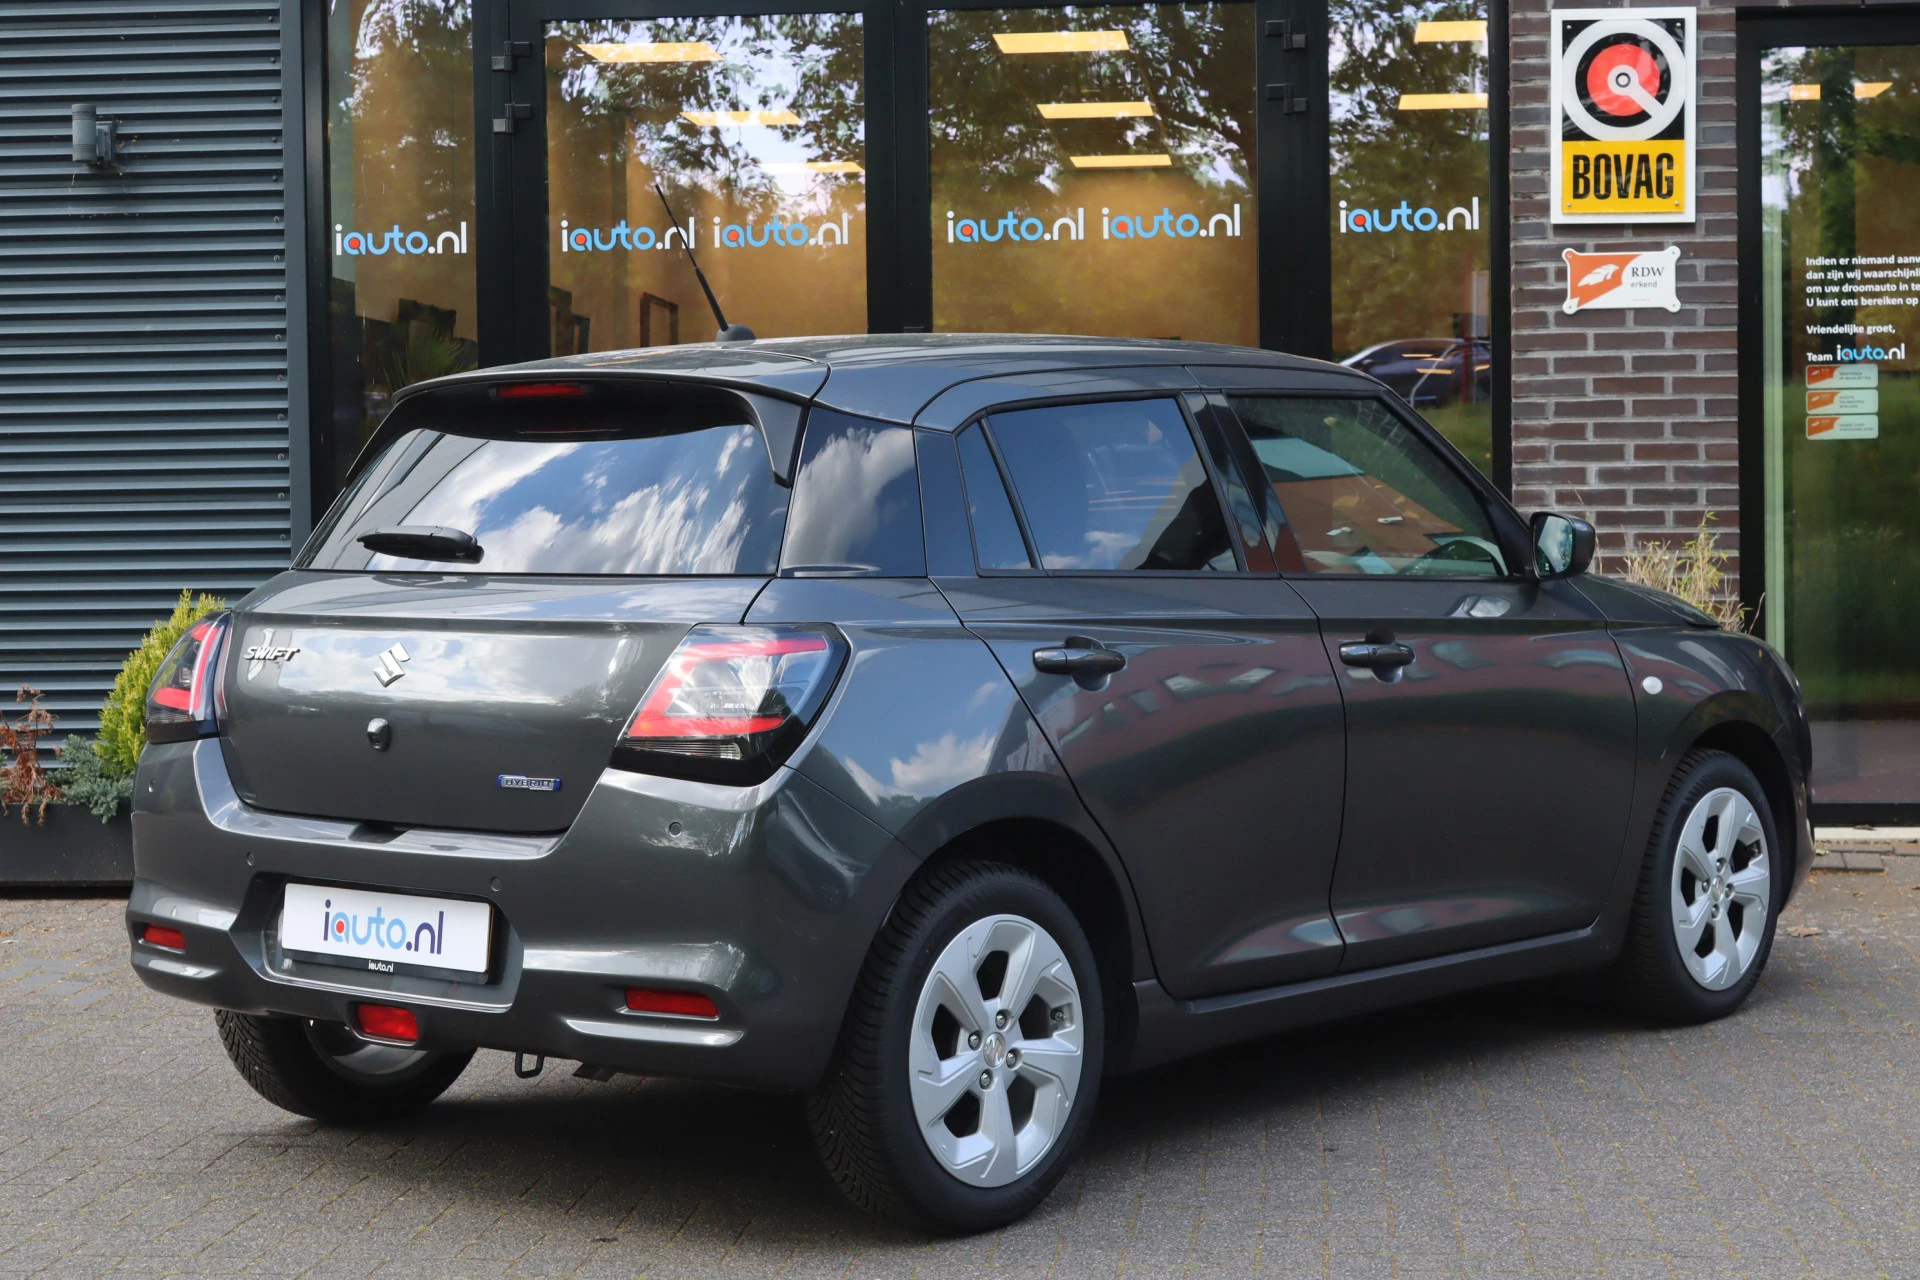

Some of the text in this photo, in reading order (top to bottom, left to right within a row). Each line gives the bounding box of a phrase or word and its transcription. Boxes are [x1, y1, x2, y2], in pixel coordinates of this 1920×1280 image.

[1572, 153, 1674, 200] BOVAG
[1101, 203, 1241, 240] iauto.nl
[1338, 196, 1479, 234] iauto.nl
[713, 212, 849, 249] iauto.nl
[946, 207, 1085, 243] iauto.nl
[335, 221, 467, 256] iauto.nl
[561, 216, 695, 252] iauto.nl
[1806, 256, 1837, 266] Indien
[1839, 257, 1850, 265] er
[1852, 255, 1895, 265] niemand
[1631, 266, 1664, 277] RDW
[1806, 270, 1825, 280] dan
[1827, 269, 1844, 281] zijn
[1846, 269, 1861, 280] wij
[1825, 285, 1840, 293] uw
[1842, 283, 1897, 292] droomauto
[1899, 282, 1909, 291] in
[1806, 296, 1919, 307] U kunt ons bereiken op
[1806, 324, 1896, 335] Vriendelijke groet,
[1806, 343, 1905, 362] Team iauto.nl
[243, 646, 300, 662] SWIFT
[505, 779, 551, 787] HYBRID
[323, 899, 444, 955] iauto.nl
[368, 959, 394, 973] iauto.nl
